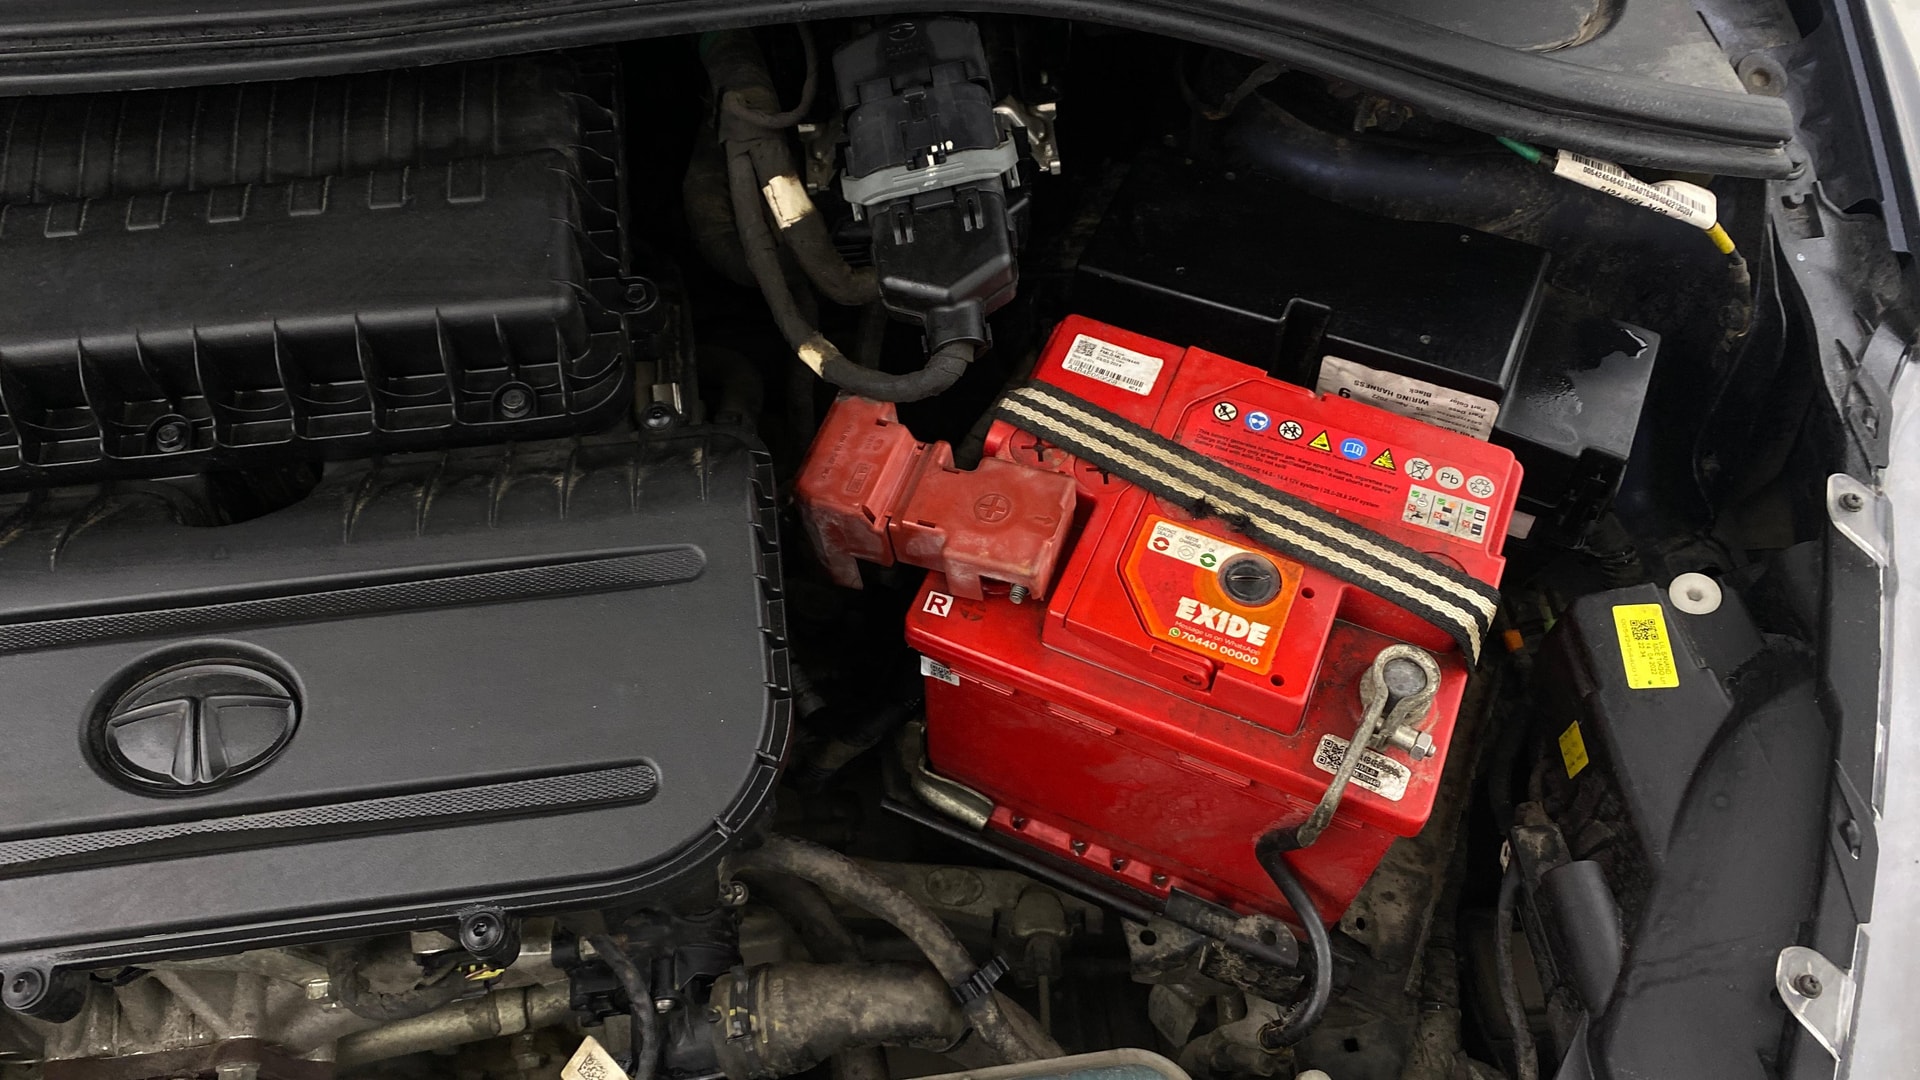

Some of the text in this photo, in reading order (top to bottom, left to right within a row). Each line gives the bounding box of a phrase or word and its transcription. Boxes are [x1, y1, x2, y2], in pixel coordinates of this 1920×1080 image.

[1353, 380, 1394, 396] HARNESS
[1408, 387, 1431, 398] Black
[1395, 391, 1430, 406] WIRING
[1234, 461, 1260, 473] VOLTAGE
[1439, 471, 1459, 485] Pb
[1157, 525, 1176, 535] CONTACT
[1178, 537, 1201, 548] CHARGING
[1184, 534, 1199, 542] NEEDS
[927, 594, 949, 615] R
[1175, 596, 1271, 646] EXIDE
[1175, 621, 1203, 636] Message
[1213, 634, 1223, 642] on
[1224, 637, 1261, 656] WhatsApp
[1181, 631, 1259, 666] 70440 00000
